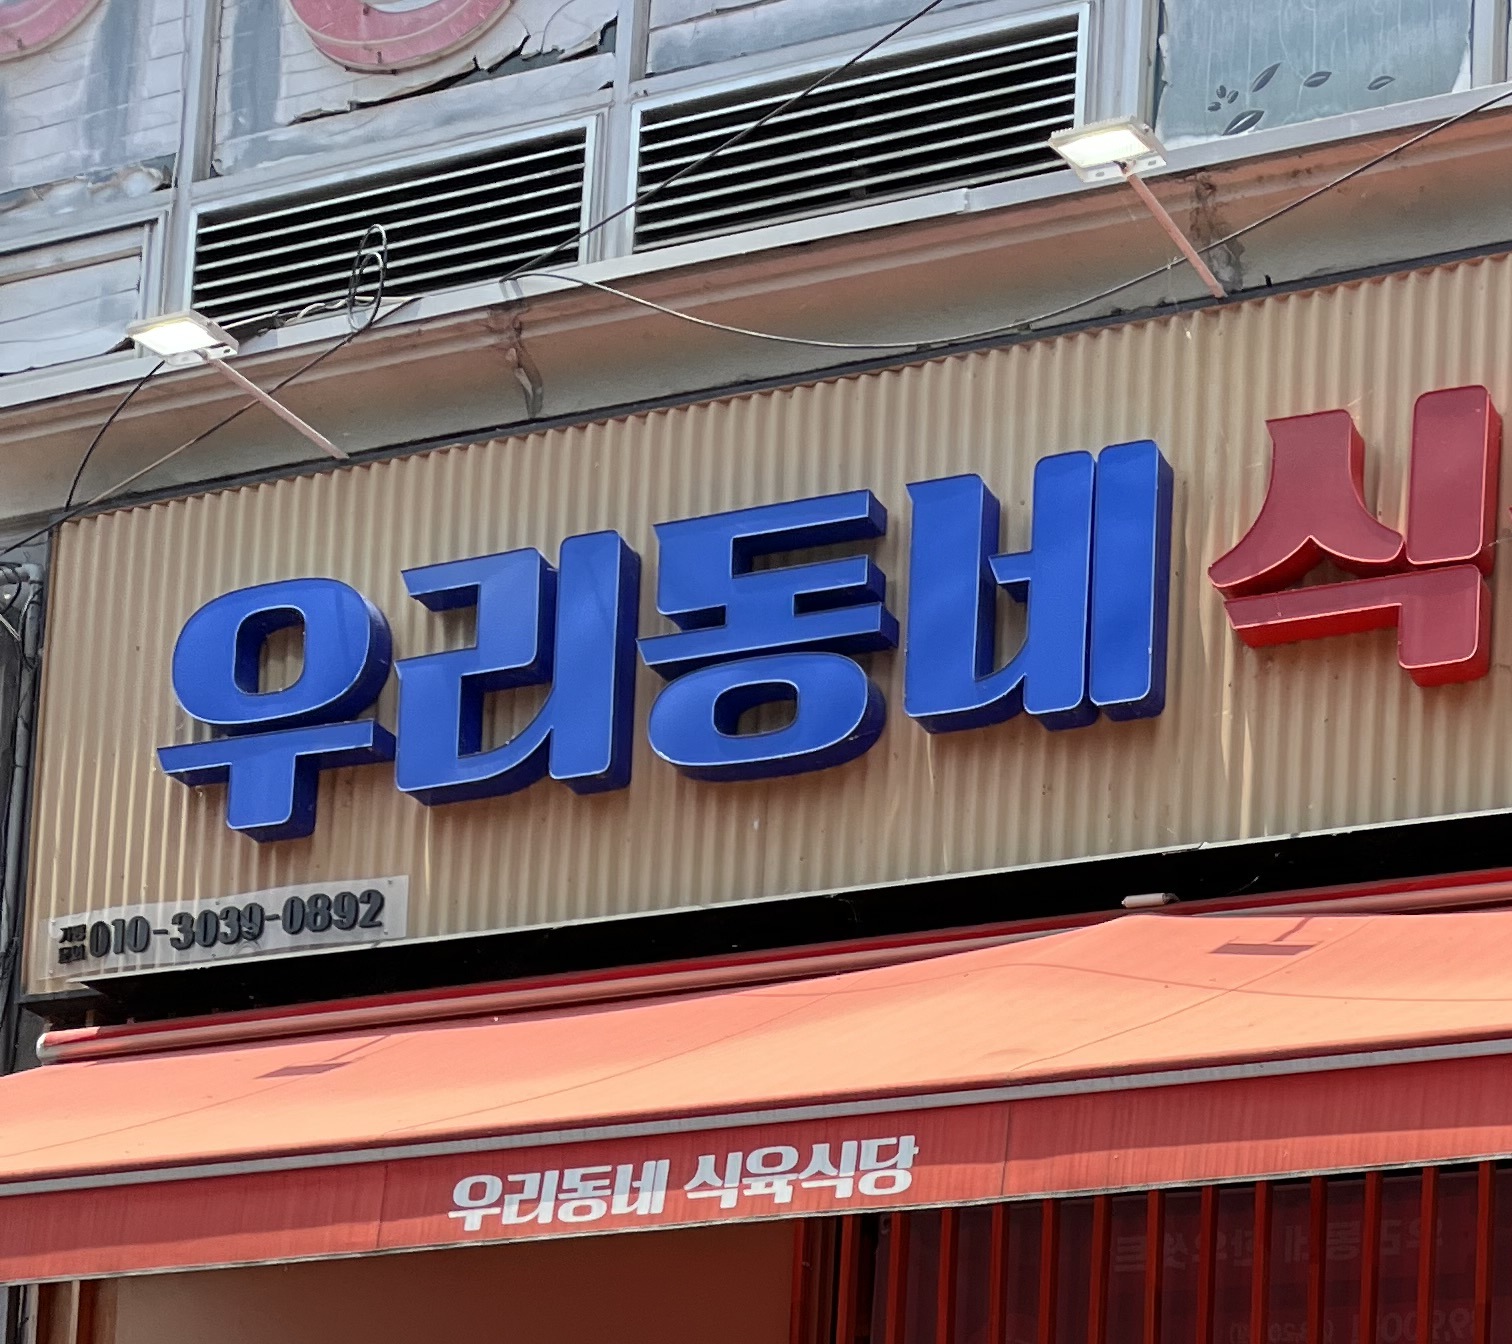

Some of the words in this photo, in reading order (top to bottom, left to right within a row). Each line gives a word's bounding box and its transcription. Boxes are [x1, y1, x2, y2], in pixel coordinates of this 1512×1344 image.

[157, 439, 1174, 843] 우리동네
[89, 889, 385, 958] 010-3039-0892
[447, 1159, 669, 1231] 우리동네
[684, 1135, 919, 1209] 식육식당
